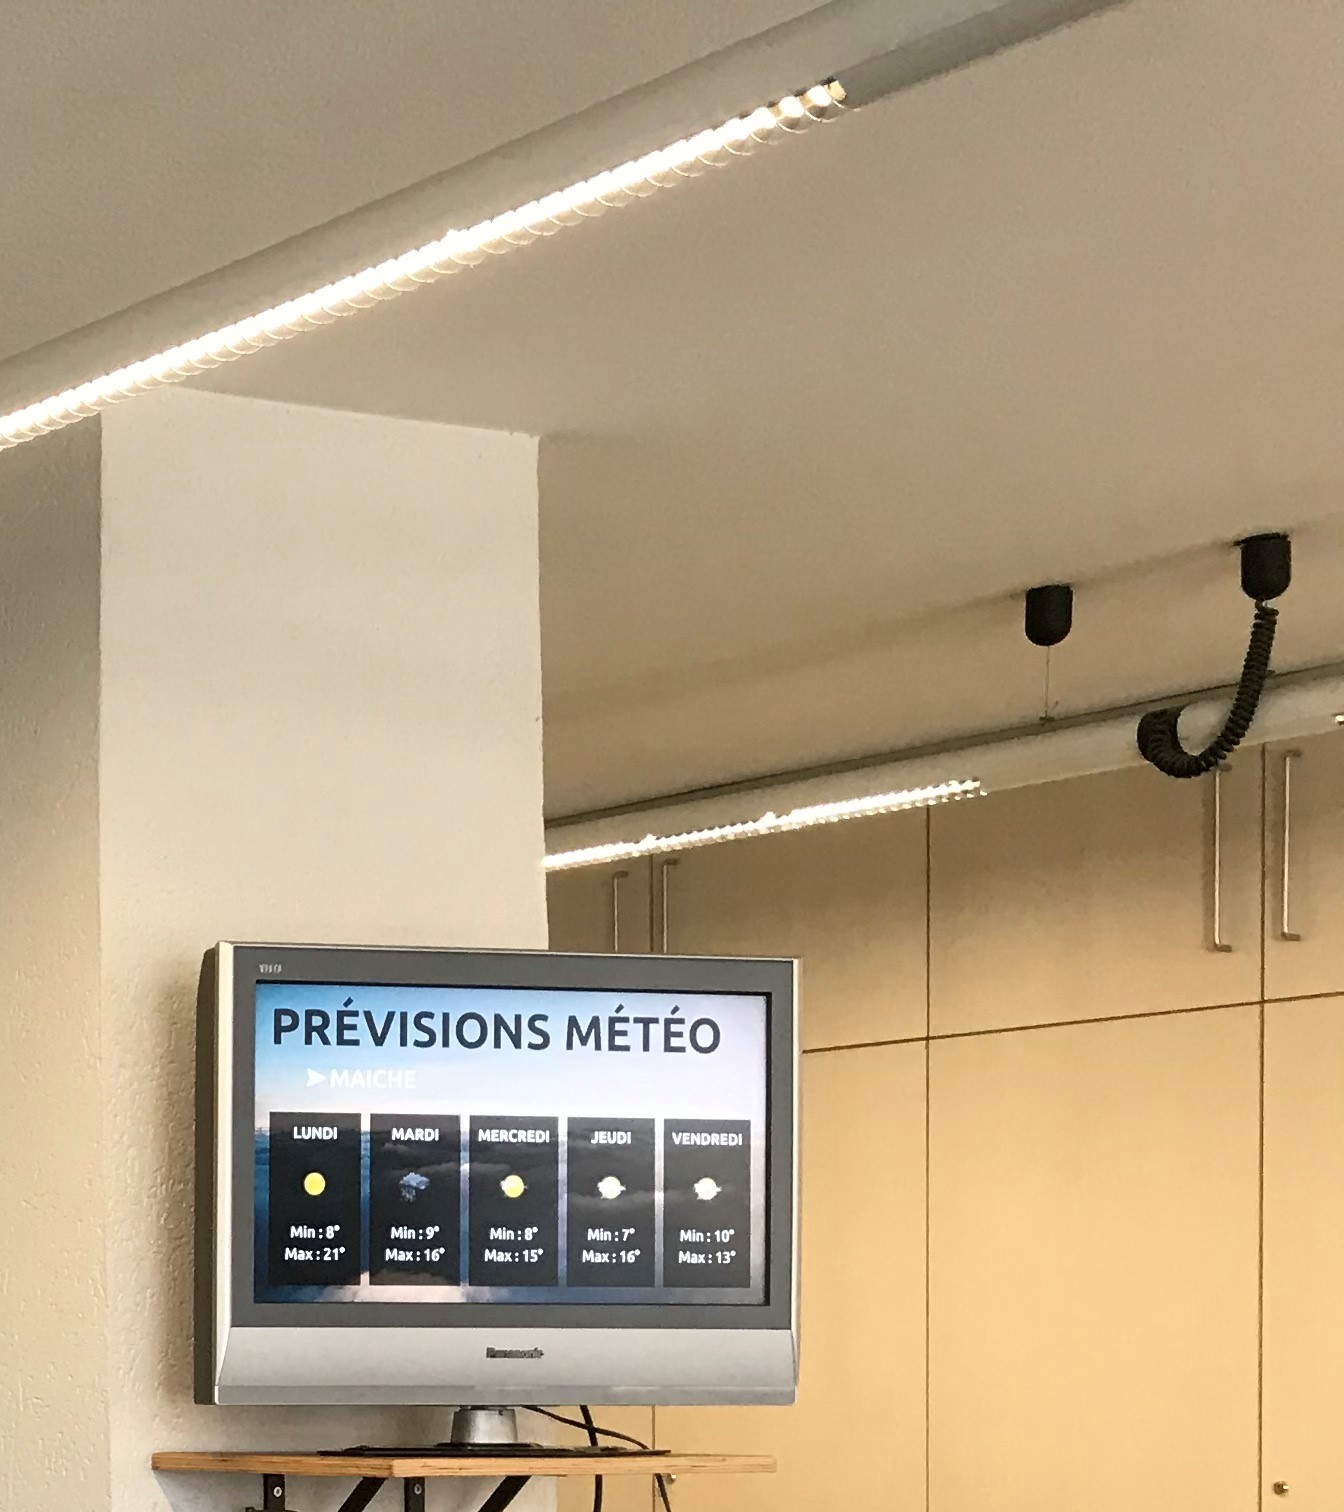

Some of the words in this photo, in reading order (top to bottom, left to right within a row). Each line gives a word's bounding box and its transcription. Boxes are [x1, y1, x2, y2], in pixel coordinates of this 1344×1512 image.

[273, 996, 551, 1051] PRÉVISIONS
[566, 1004, 721, 1054] MÉTÉO
[330, 1068, 416, 1089] MAICHE
[293, 1126, 338, 1140] LUNDI
[391, 1128, 439, 1142] MARDI
[478, 1129, 550, 1143] MERCREDI
[590, 1131, 632, 1144] JEUDI
[672, 1132, 742, 1146] VENDREDI
[290, 1226, 316, 1239] Min
[325, 1225, 341, 1239] 8°
[391, 1226, 416, 1240] Min
[426, 1225, 440, 1240] 9°
[489, 1227, 515, 1241] Min
[524, 1227, 539, 1241] 8°
[587, 1228, 612, 1241] Min
[622, 1228, 636, 1241] 7°
[680, 1229, 704, 1242] Min
[714, 1228, 735, 1242] 10°
[284, 1247, 313, 1260] Max
[323, 1246, 346, 1261] 21°
[385, 1248, 413, 1261] Max
[424, 1247, 445, 1261] 16°
[484, 1249, 512, 1262] Max
[522, 1248, 544, 1263] 15°
[582, 1250, 609, 1263] Max
[620, 1249, 641, 1263] 16°
[678, 1251, 705, 1264] Max
[716, 1250, 736, 1264] 13°
